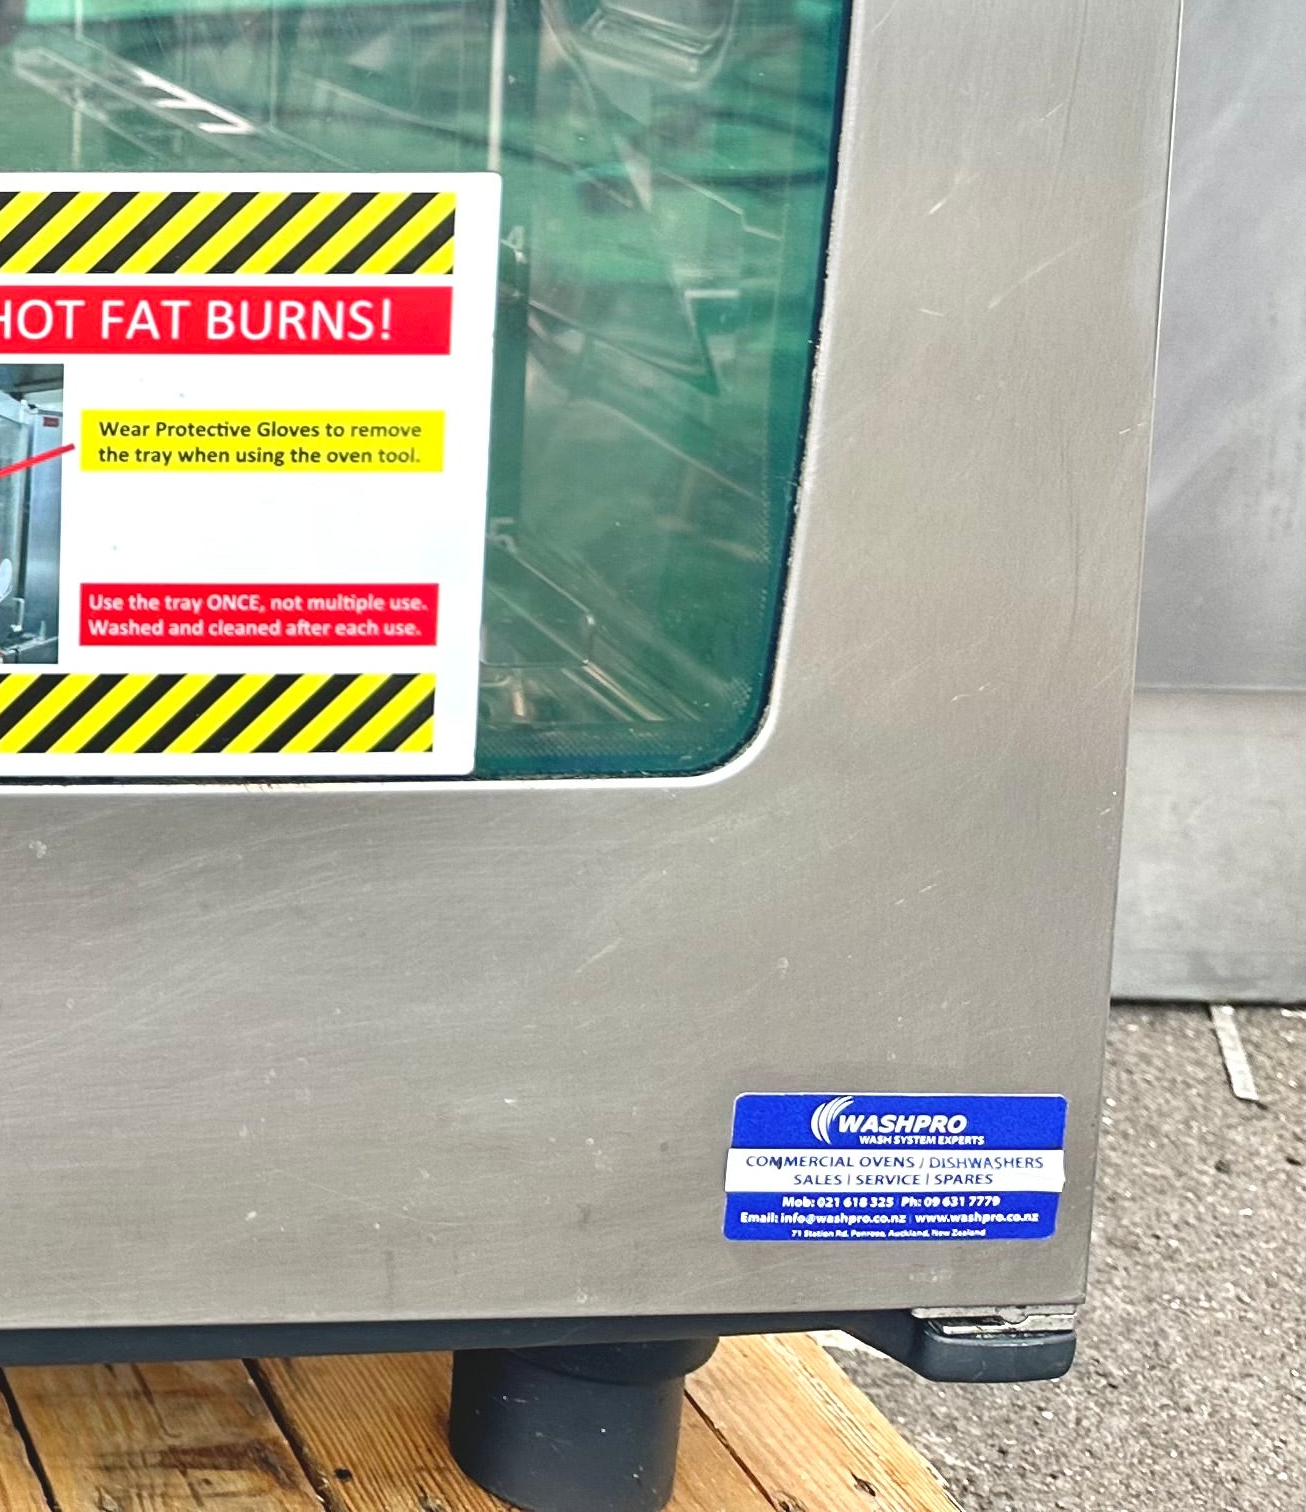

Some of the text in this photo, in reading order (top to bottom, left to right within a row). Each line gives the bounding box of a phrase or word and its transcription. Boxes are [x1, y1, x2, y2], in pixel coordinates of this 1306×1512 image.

[101, 299, 191, 340] FAT
[207, 299, 392, 341] BURNS!
[99, 421, 422, 438] Wear Protective Gloves to remove
[98, 446, 421, 466] the tray when using the oven tool.
[89, 594, 428, 614] Use the tray ONCE, not multiple use.
[89, 619, 422, 637] Washed and cleaned after each use.
[839, 1114, 967, 1134] WASHPRO
[859, 1135, 985, 1146] WASH SYSTEM EXPERTS
[746, 1155, 854, 1169] COMMERCIAL
[859, 1156, 915, 1168] OVENS
[929, 1156, 1044, 1169] DISHWASHERS
[794, 1174, 843, 1185] SALES
[856, 1174, 921, 1185] SERVICE
[934, 1174, 993, 1185] SPARES
[782, 1196, 815, 1208] Mob:
[817, 1197, 839, 1208] 021
[843, 1197, 868, 1208] 618
[869, 1197, 894, 1208] 325
[901, 1196, 922, 1208] Ph:
[923, 1196, 940, 1207] 09
[942, 1196, 965, 1207] 631
[740, 1212, 1039, 1225] Email: info@washpro.co.nz www.washpro.co.nz
[931, 1229, 950, 1237] New
[952, 1228, 986, 1237] Zealand
